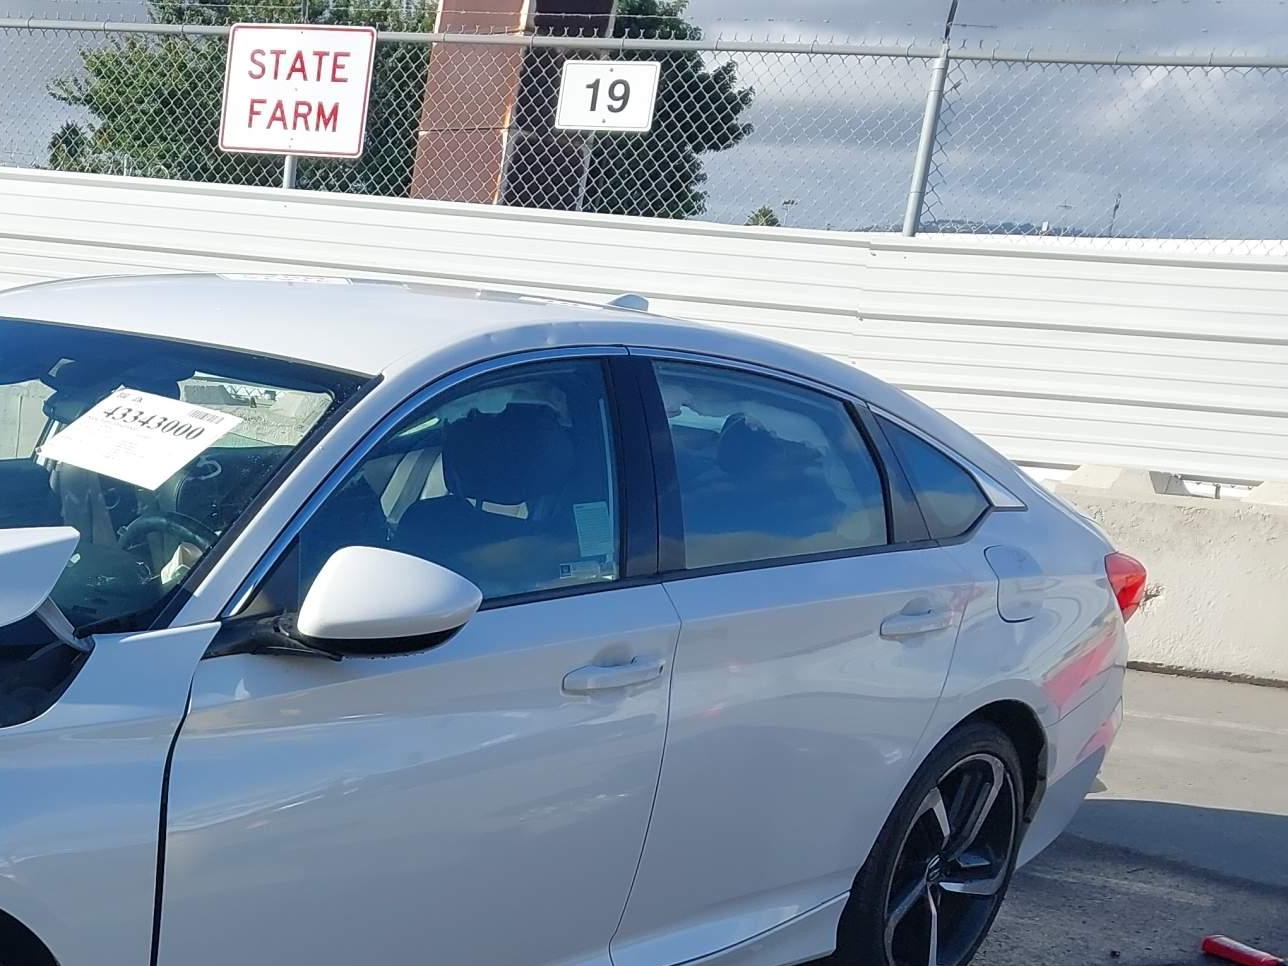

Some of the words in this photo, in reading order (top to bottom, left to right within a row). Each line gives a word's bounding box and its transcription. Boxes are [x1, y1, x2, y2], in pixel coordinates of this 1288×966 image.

[248, 48, 351, 84] STATE
[586, 78, 631, 113] 19
[247, 98, 340, 133] FARM
[103, 405, 205, 440] 43343000
